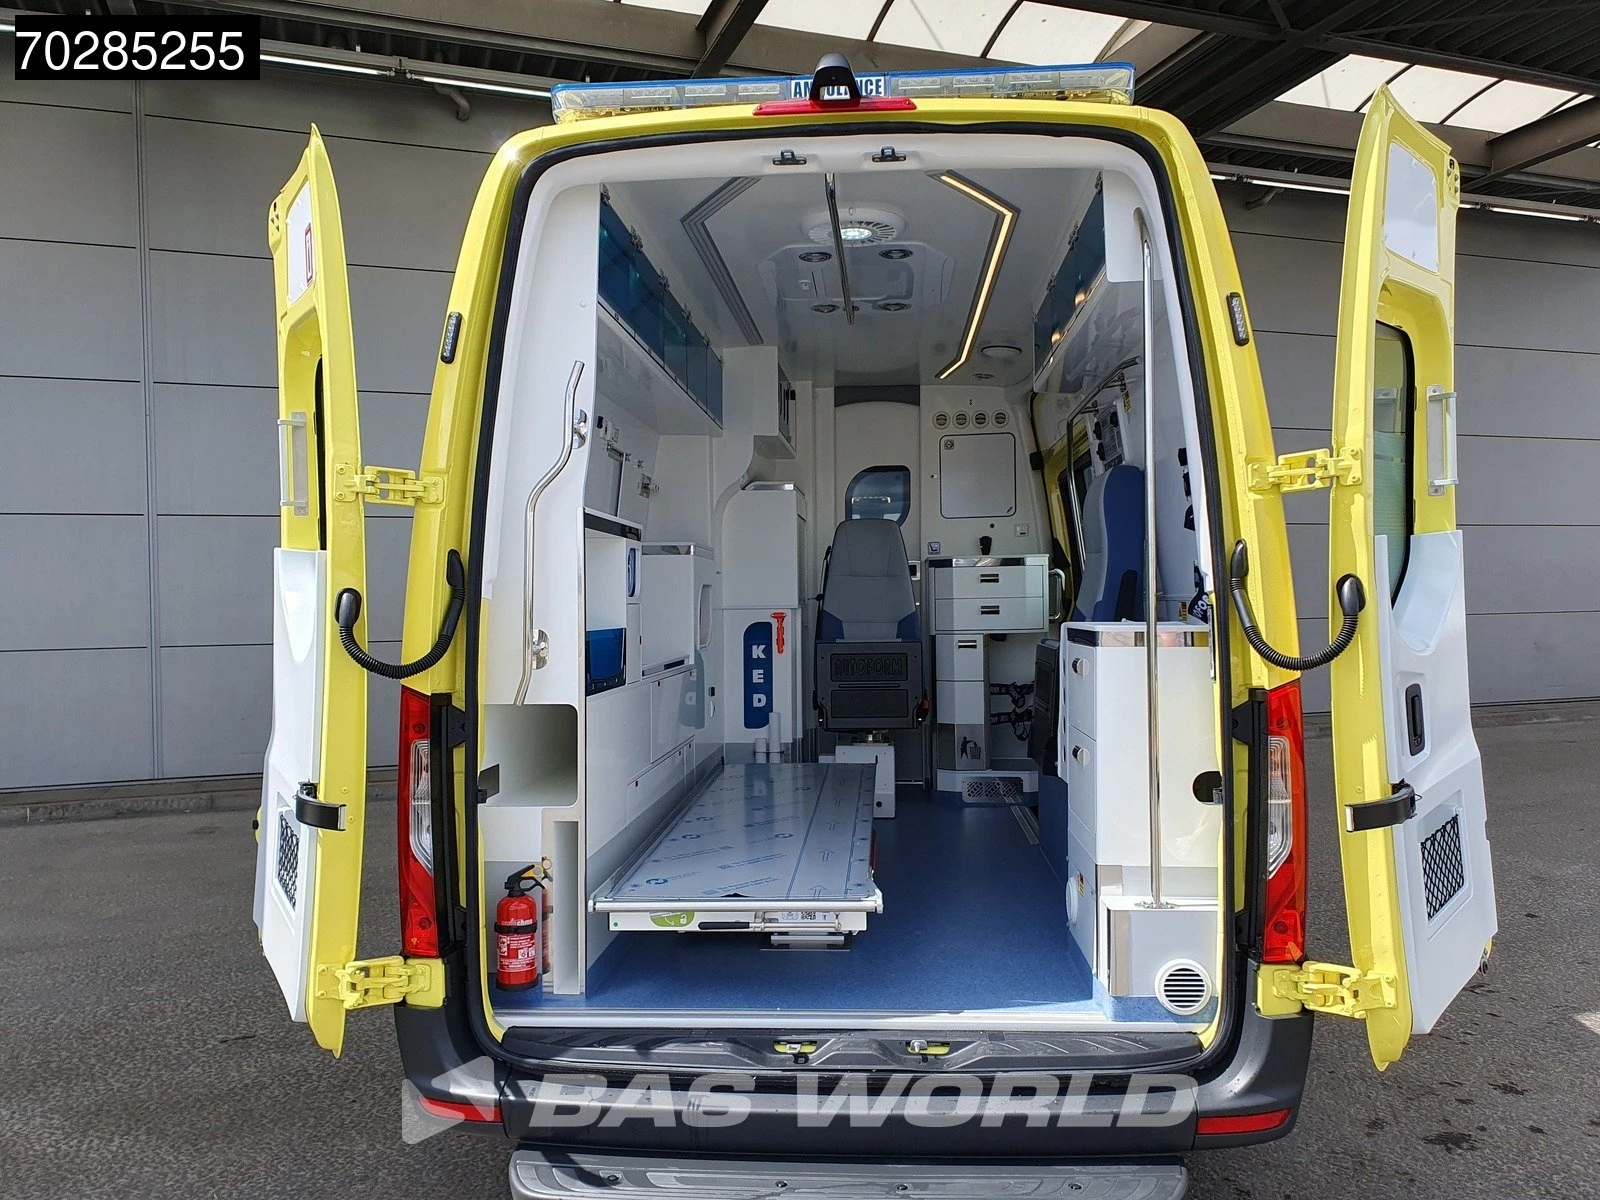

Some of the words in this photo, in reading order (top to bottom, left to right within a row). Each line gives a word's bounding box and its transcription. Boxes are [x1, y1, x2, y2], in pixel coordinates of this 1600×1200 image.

[793, 78, 883, 98] AMULNCE
[752, 644, 767, 708] KED
[835, 658, 903, 676] AUTOFORM
